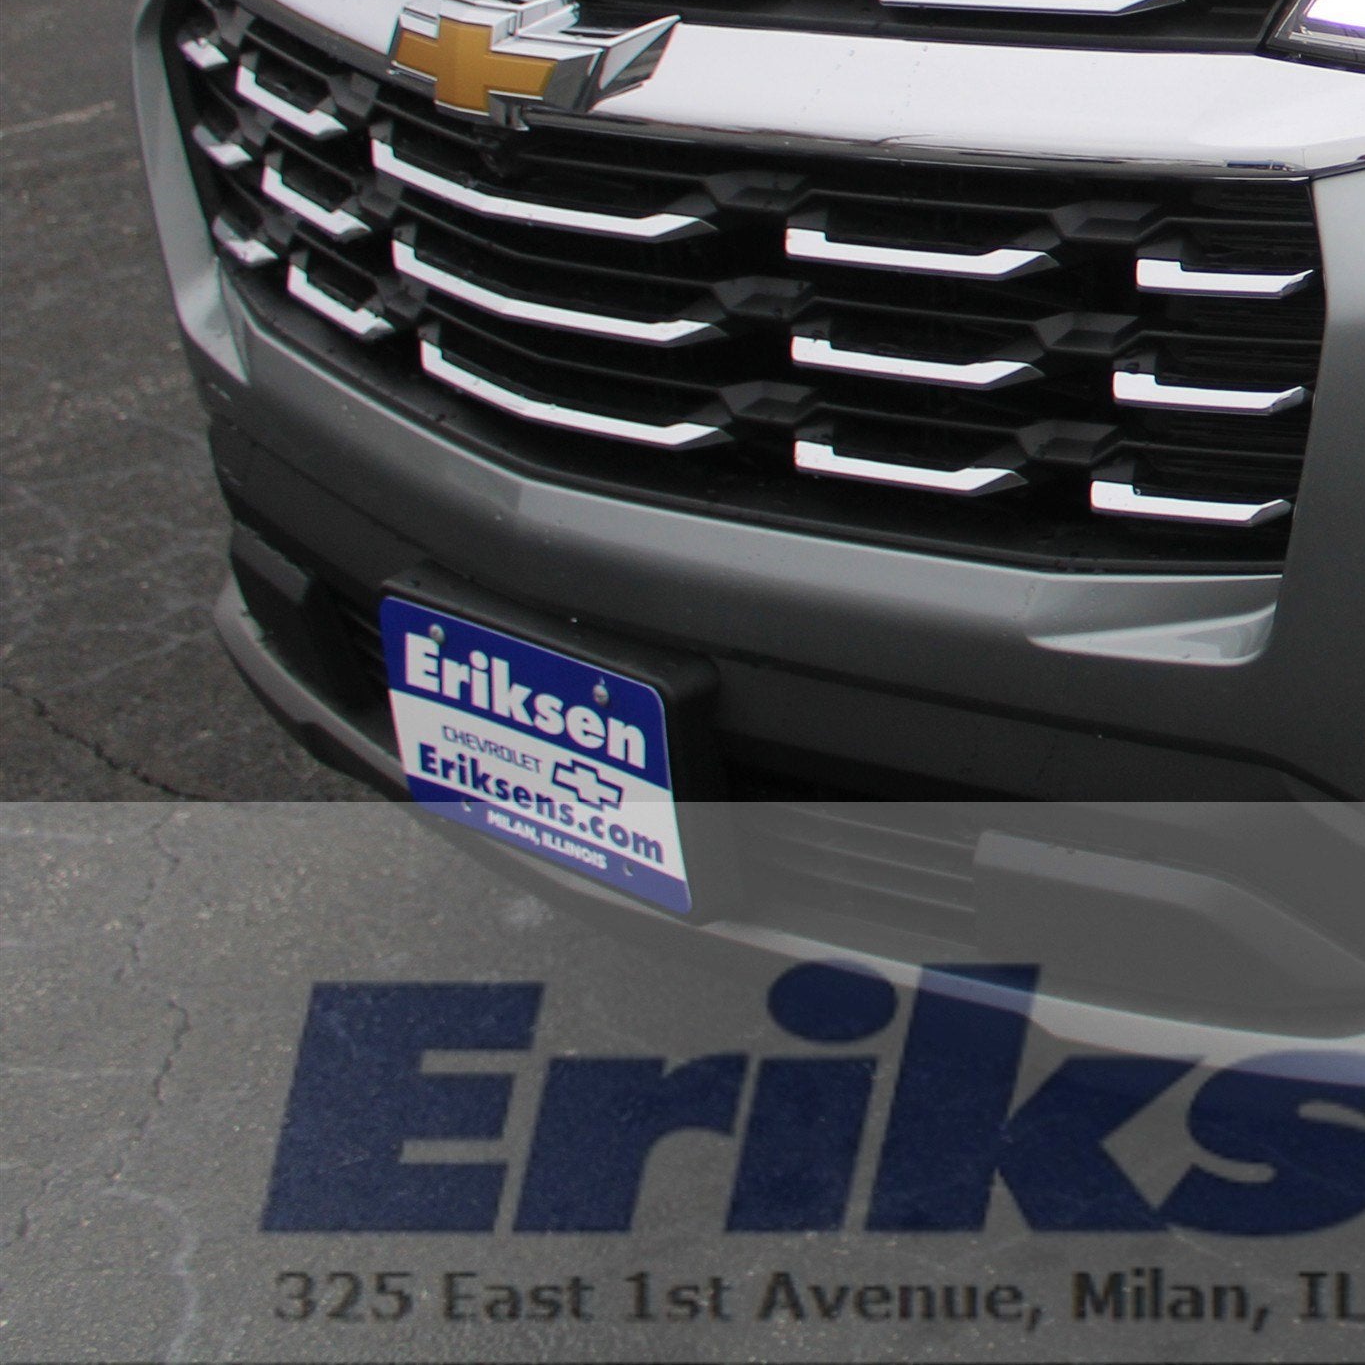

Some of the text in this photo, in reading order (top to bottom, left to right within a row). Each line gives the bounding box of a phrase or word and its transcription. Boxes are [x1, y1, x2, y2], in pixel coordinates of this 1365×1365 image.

[405, 632, 647, 770] Eriksen
[442, 725, 543, 775] CHEVROLET
[417, 742, 664, 865] Eriksens.com
[486, 809, 608, 871] MILAN, ILLINOIS
